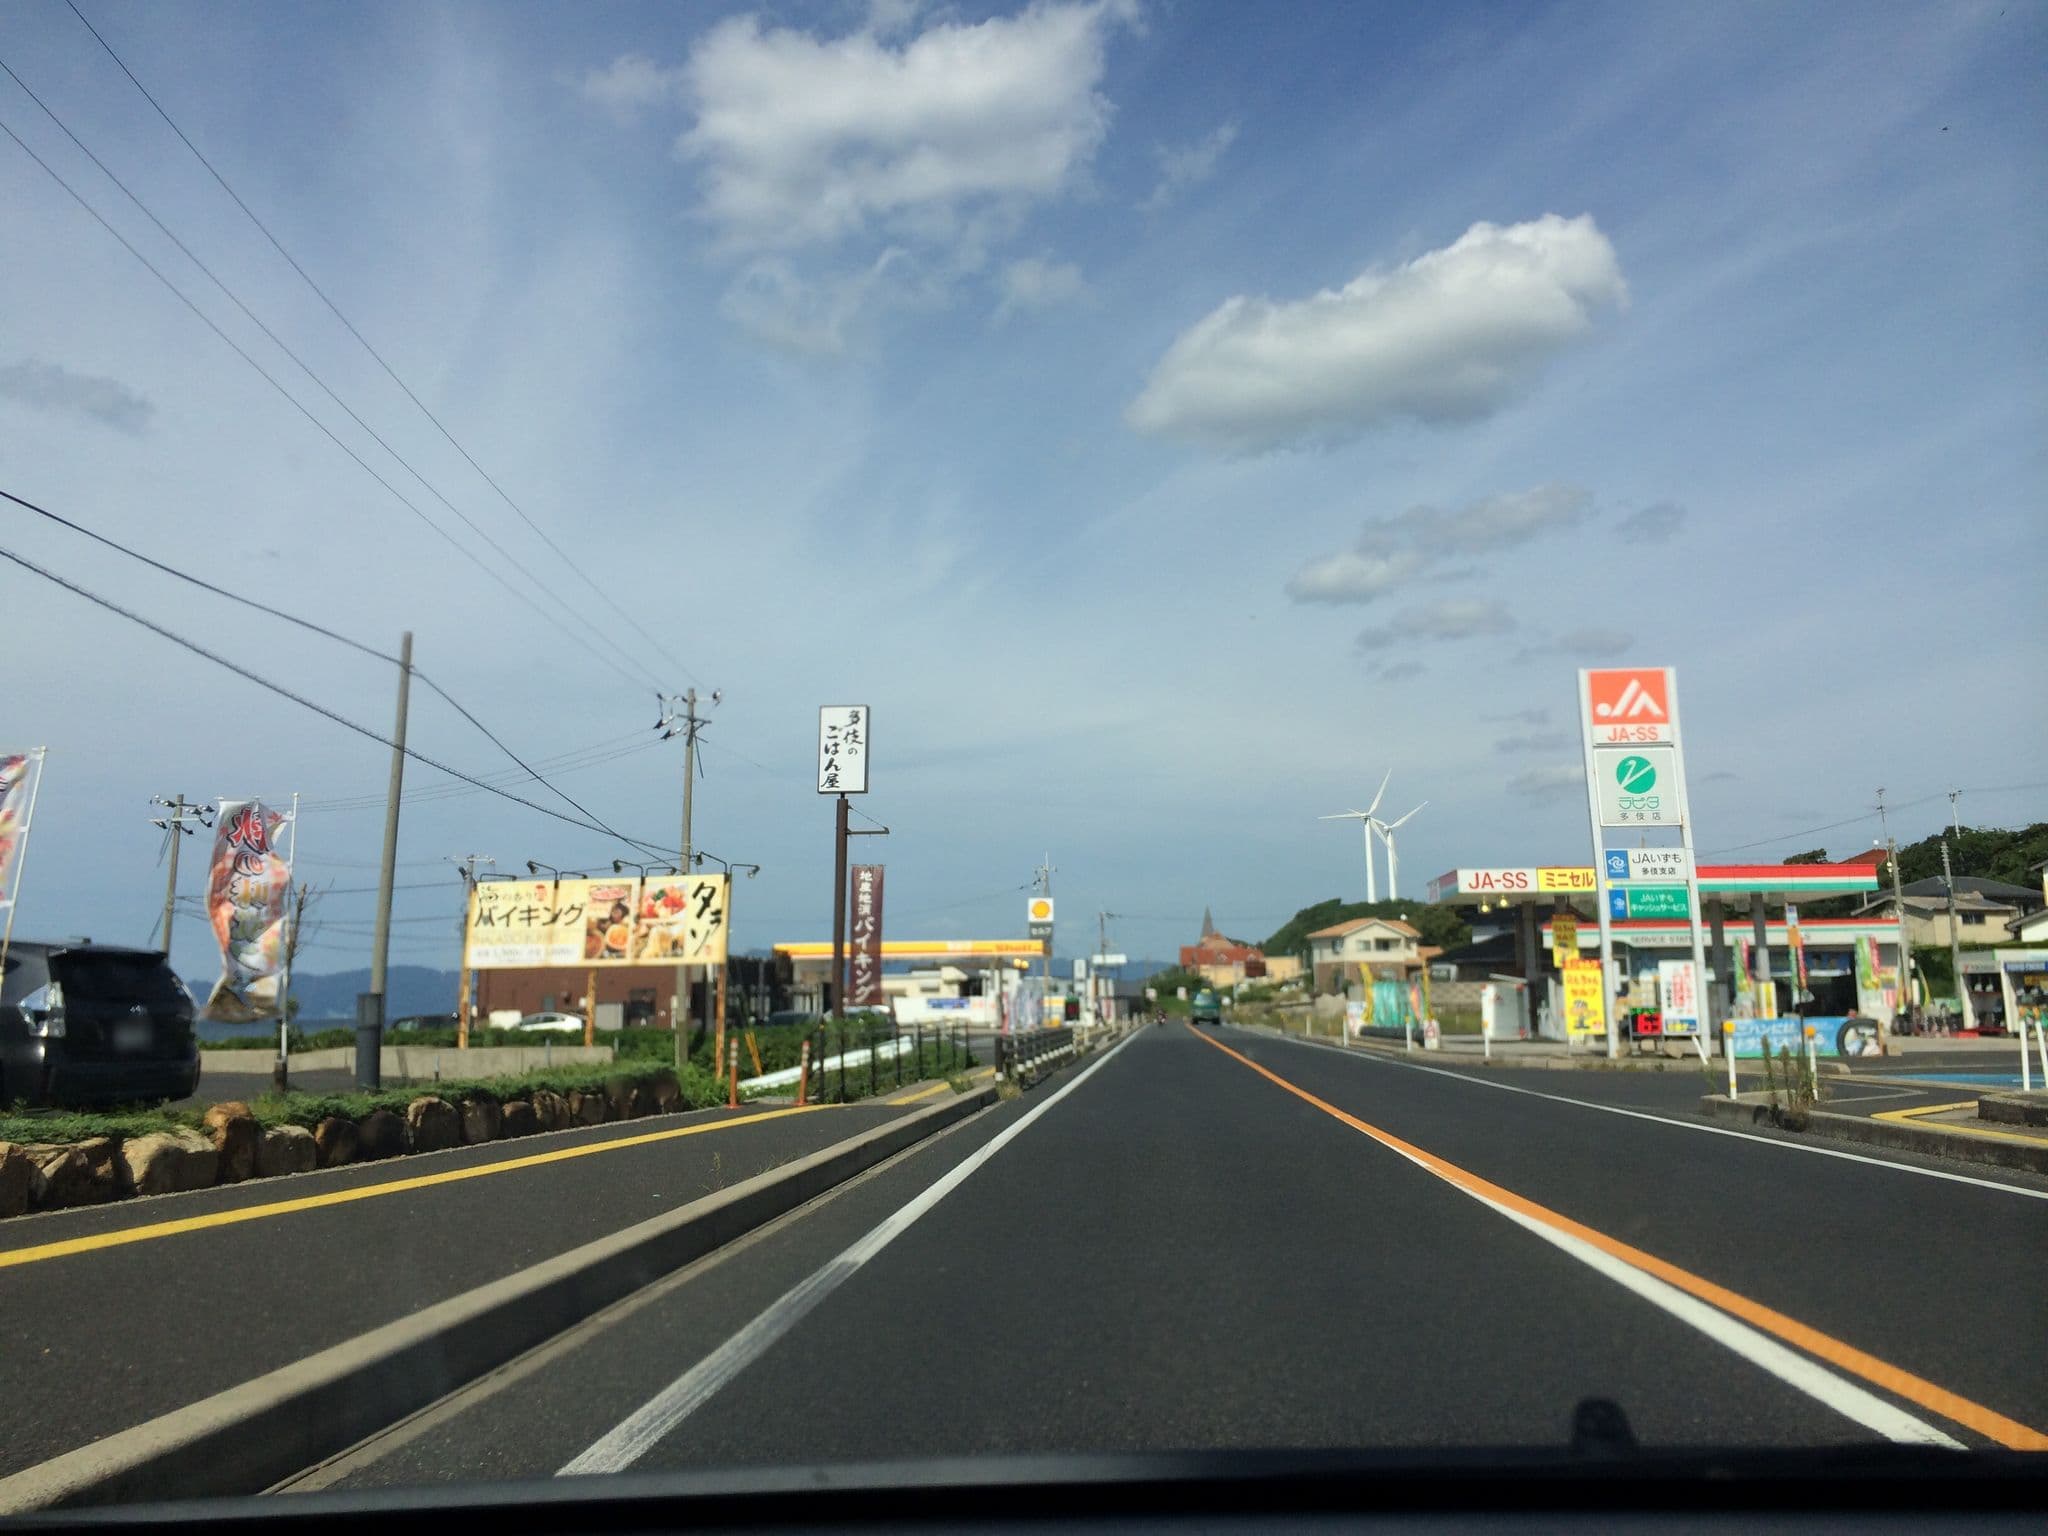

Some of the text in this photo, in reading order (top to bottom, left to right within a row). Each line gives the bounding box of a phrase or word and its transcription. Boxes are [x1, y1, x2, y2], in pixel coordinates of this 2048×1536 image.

[1607, 726, 1659, 742] JA-SS
[820, 725, 842, 789] ごはん屋
[1468, 872, 1529, 889] JA-SS
[474, 903, 585, 928] バイキング
